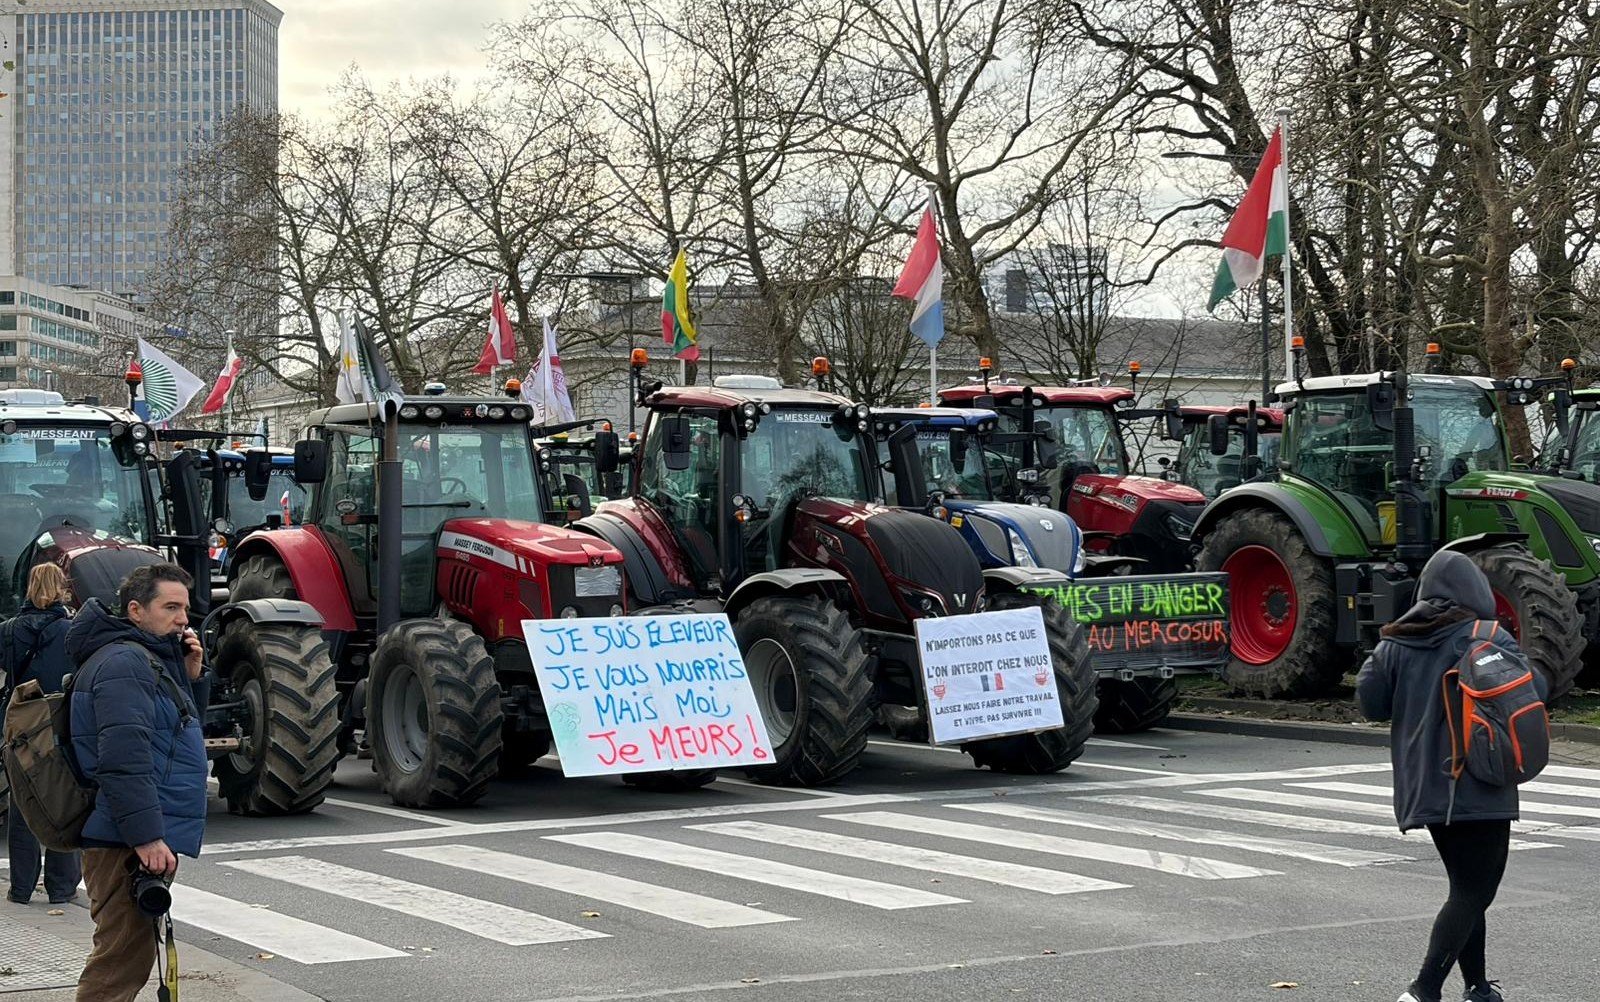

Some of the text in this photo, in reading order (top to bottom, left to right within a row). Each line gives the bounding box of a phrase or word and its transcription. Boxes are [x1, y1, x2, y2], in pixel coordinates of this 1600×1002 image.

[784, 413, 832, 423] MESSEANT
[30, 429, 96, 439] MESSEANT
[1486, 486, 1518, 497] FENDT
[454, 537, 472, 550] MASSEY
[471, 542, 495, 557] FERGUSON
[1016, 581, 1225, 623] MES EN DANGER
[540, 627, 588, 656] JE
[926, 629, 1036, 652] N'IMPORTONS PAS CE QUE
[1088, 620, 1228, 651] AU MERCOSUR
[545, 665, 590, 691] JE
[595, 663, 649, 691] VOUS
[927, 654, 1048, 678] L'ON INTERDIT CHEZ NOUS
[935, 692, 1054, 715] LAISSEZ NOUS FAIRE NOTRE TRAVAIL
[953, 718, 963, 727] ET
[987, 714, 1000, 723] PAS
[1001, 709, 1033, 721] SURVIVRE
[588, 730, 644, 766] Je
[649, 724, 743, 760] MEURS
